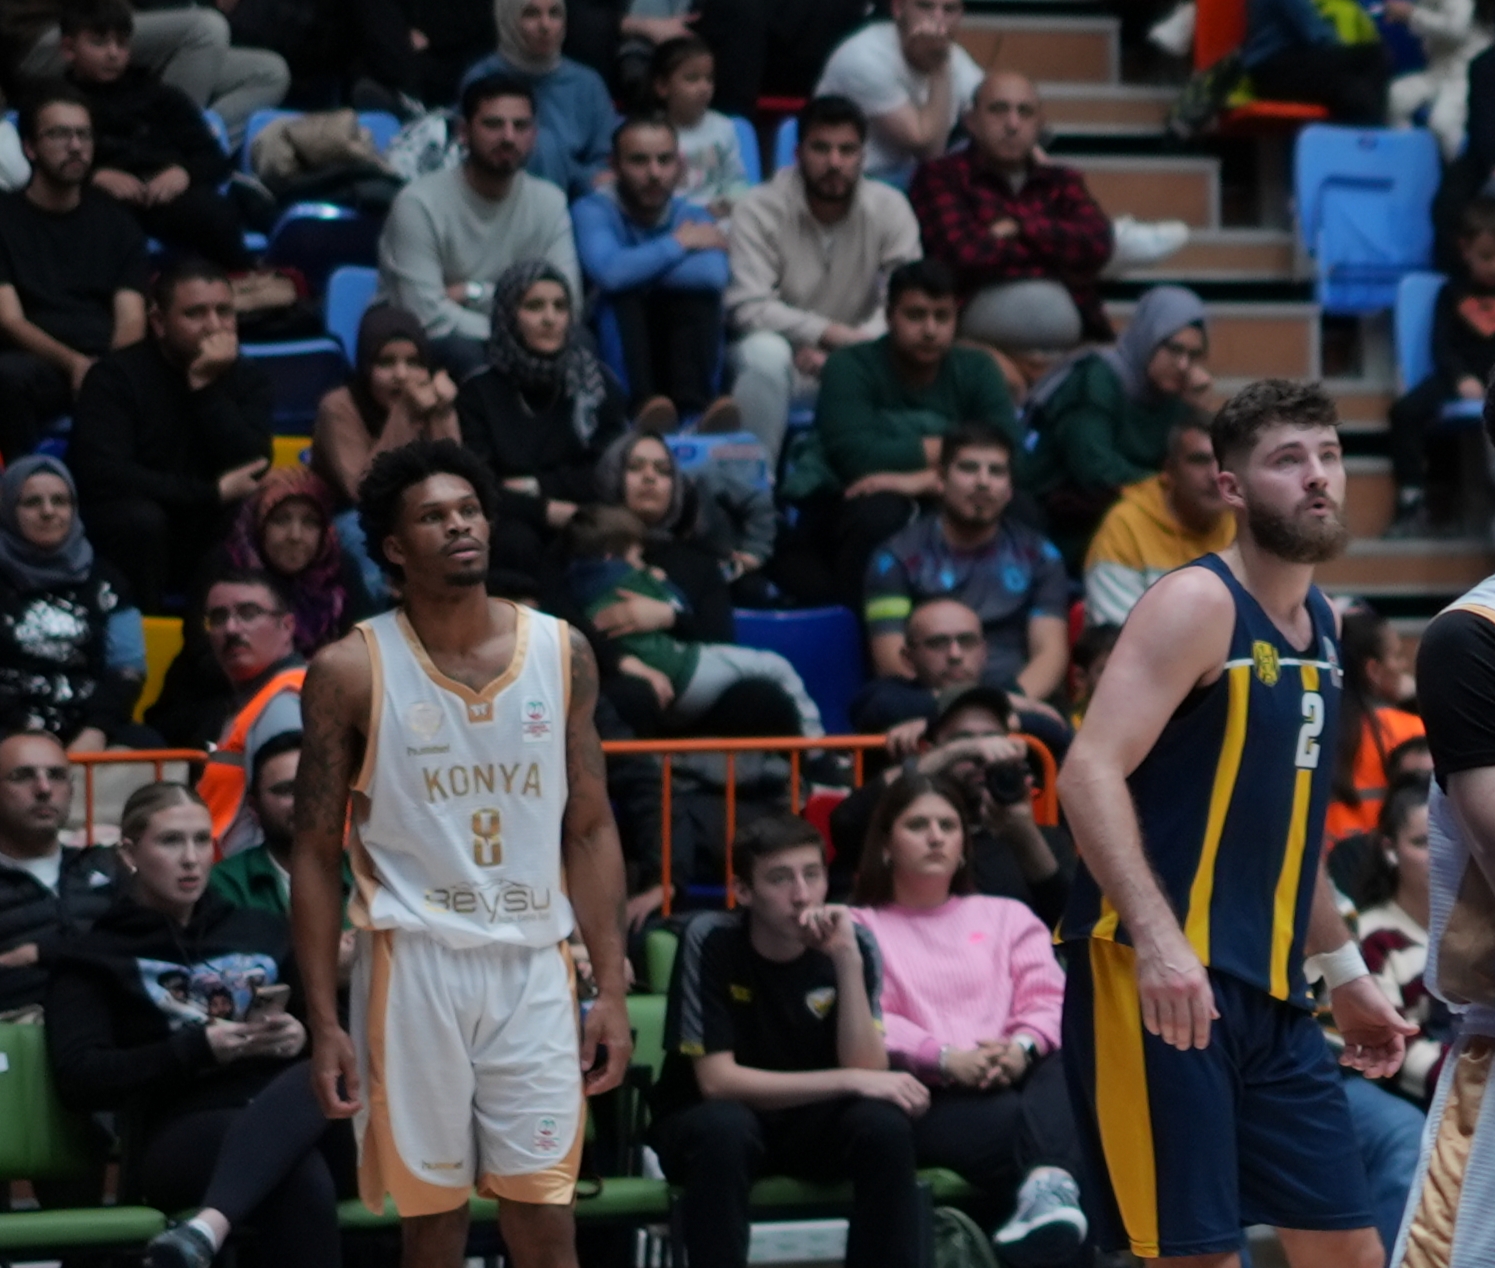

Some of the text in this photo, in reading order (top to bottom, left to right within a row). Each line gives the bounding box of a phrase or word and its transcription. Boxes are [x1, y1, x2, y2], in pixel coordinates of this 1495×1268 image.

[1294, 692, 1325, 768] 2
[422, 762, 542, 803] KONYA
[471, 807, 503, 868] 8
[423, 887, 550, 924] Beysu
